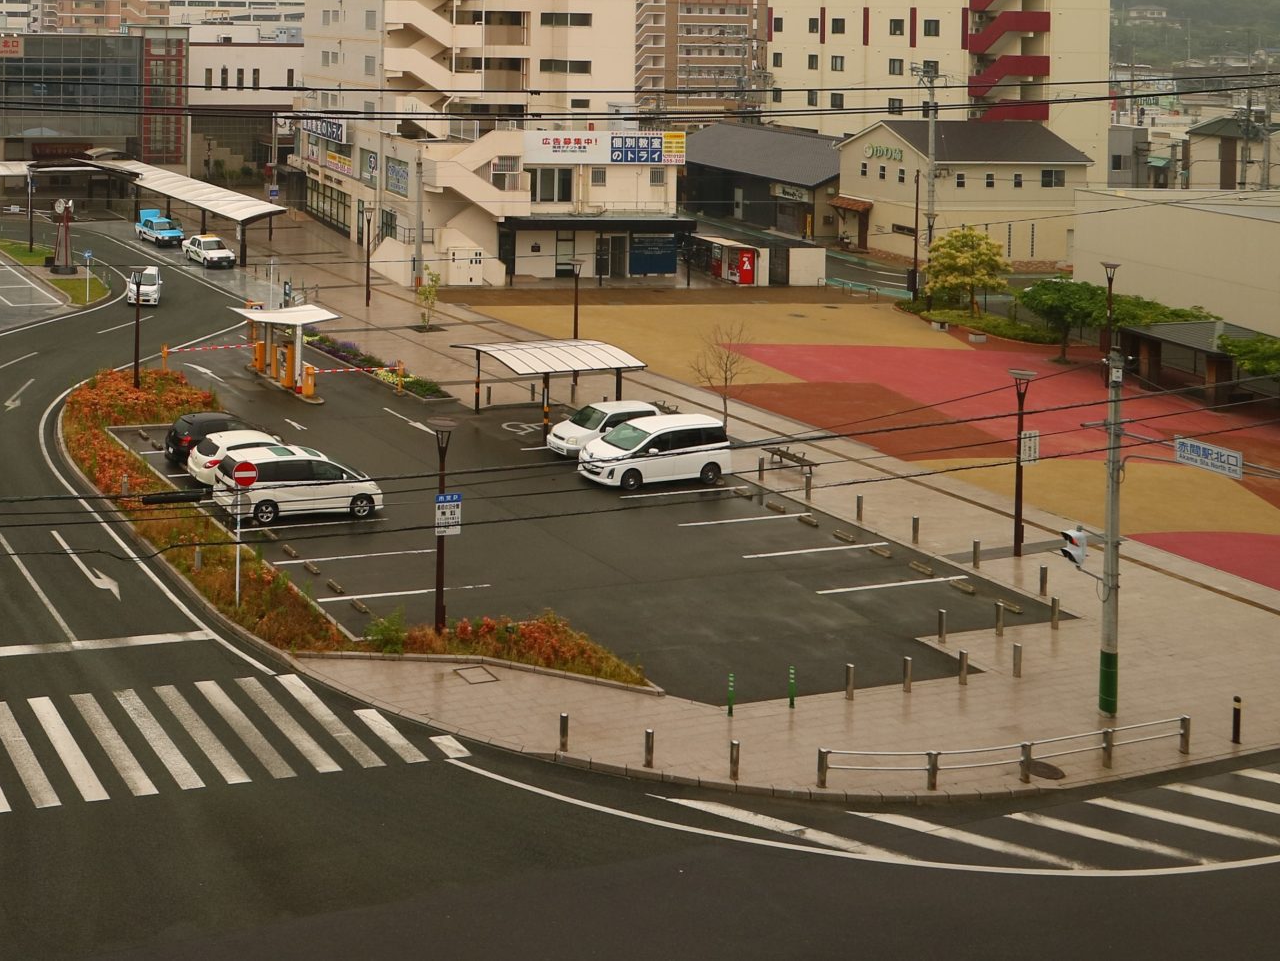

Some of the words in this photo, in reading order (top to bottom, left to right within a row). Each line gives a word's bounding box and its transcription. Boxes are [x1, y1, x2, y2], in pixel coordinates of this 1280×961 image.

[2, 40, 19, 48] 北口
[612, 137, 662, 148] 個別教室
[612, 150, 661, 162] のトライ
[1178, 441, 1238, 467] 赤間駅北口
